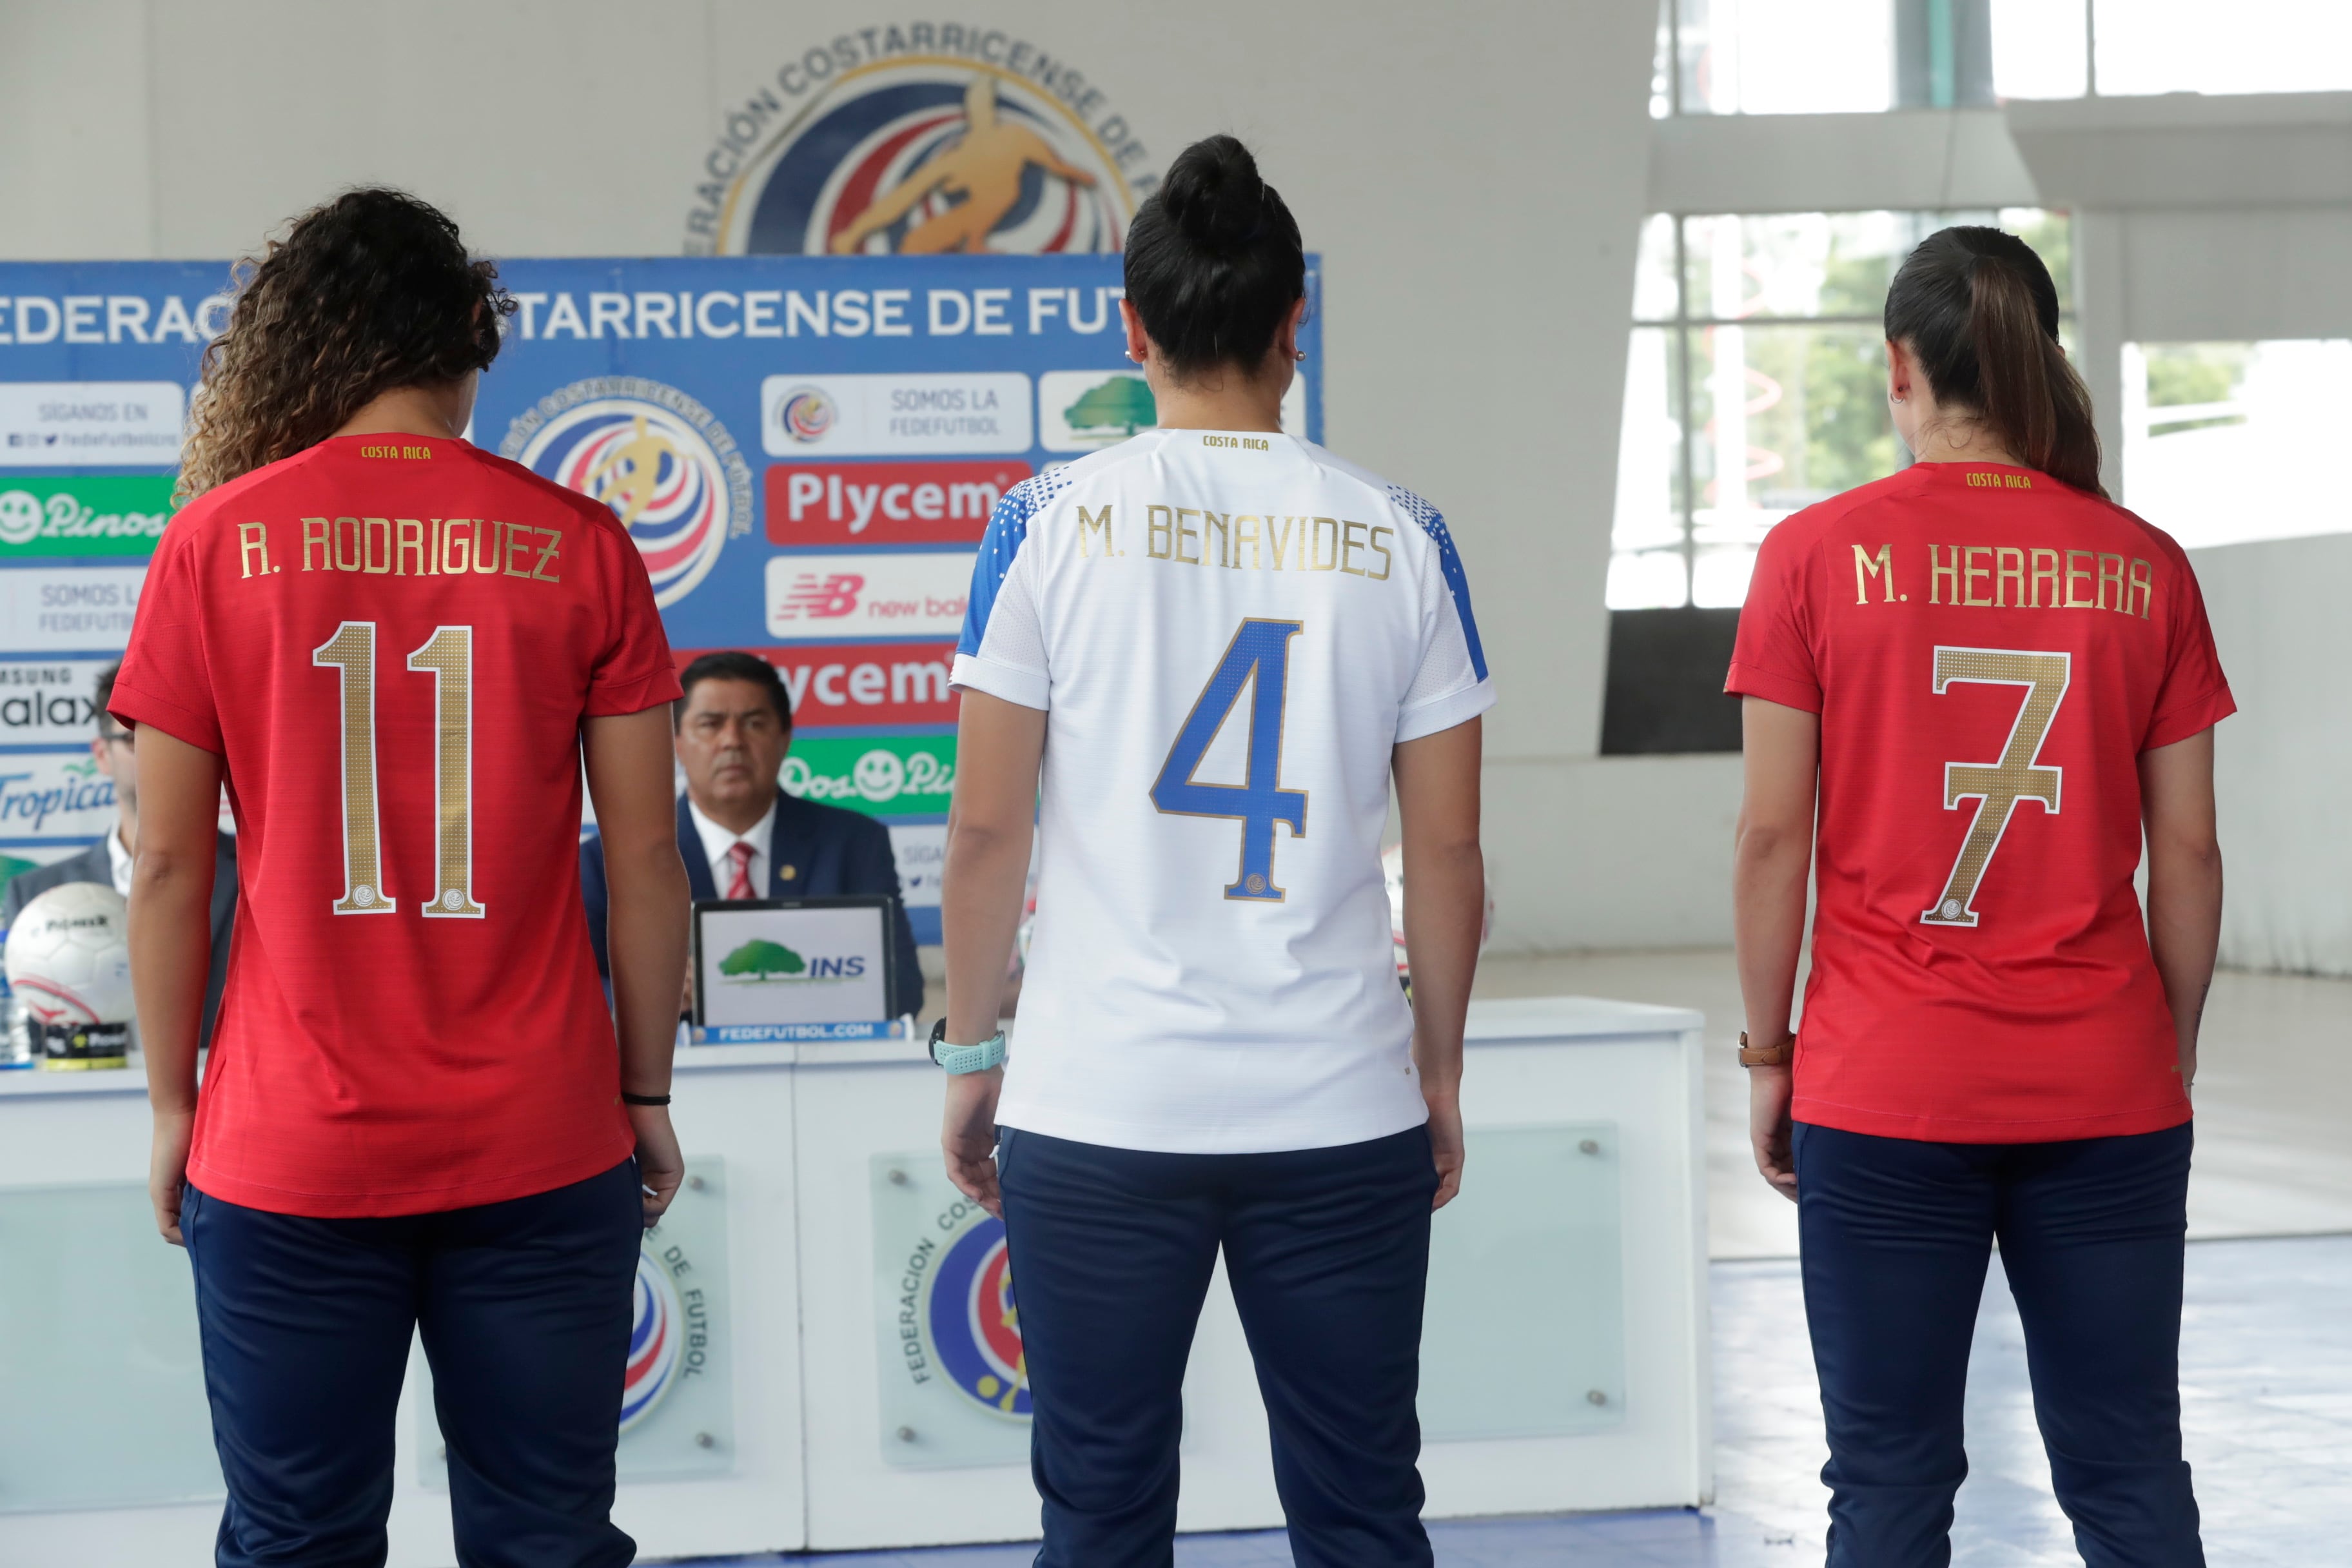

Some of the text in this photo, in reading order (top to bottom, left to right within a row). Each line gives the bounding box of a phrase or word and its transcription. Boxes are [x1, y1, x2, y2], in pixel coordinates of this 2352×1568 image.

[1097, 112, 1150, 174] DE
[0, 295, 235, 344] DERAC
[498, 290, 912, 339] TARRICENSE
[928, 289, 1012, 337] DE
[890, 416, 999, 436] FEDEFUTBOL
[892, 388, 999, 411] SOMOS LA
[361, 446, 431, 460] COSTA RICA
[1203, 435, 1269, 451] COSTA RICA
[788, 473, 1000, 534] Plycem
[1966, 472, 2032, 489] COSTA RICA
[237, 516, 562, 583] R. RODRIGUEZ
[1077, 504, 1395, 581] M. BENAVIDES
[41, 583, 120, 607] SOMOS
[868, 600, 918, 618] new
[1851, 543, 2153, 620] M. HERRERA
[313, 621, 485, 919] 11
[1149, 617, 1309, 903] 4
[1919, 645, 2071, 928] 7
[810, 956, 865, 977] INS
[719, 1024, 873, 1041] FEDEFUTBOL.COM
[663, 1245, 707, 1378] DE FUTBOL
[899, 1237, 936, 1386] FEDERACION
